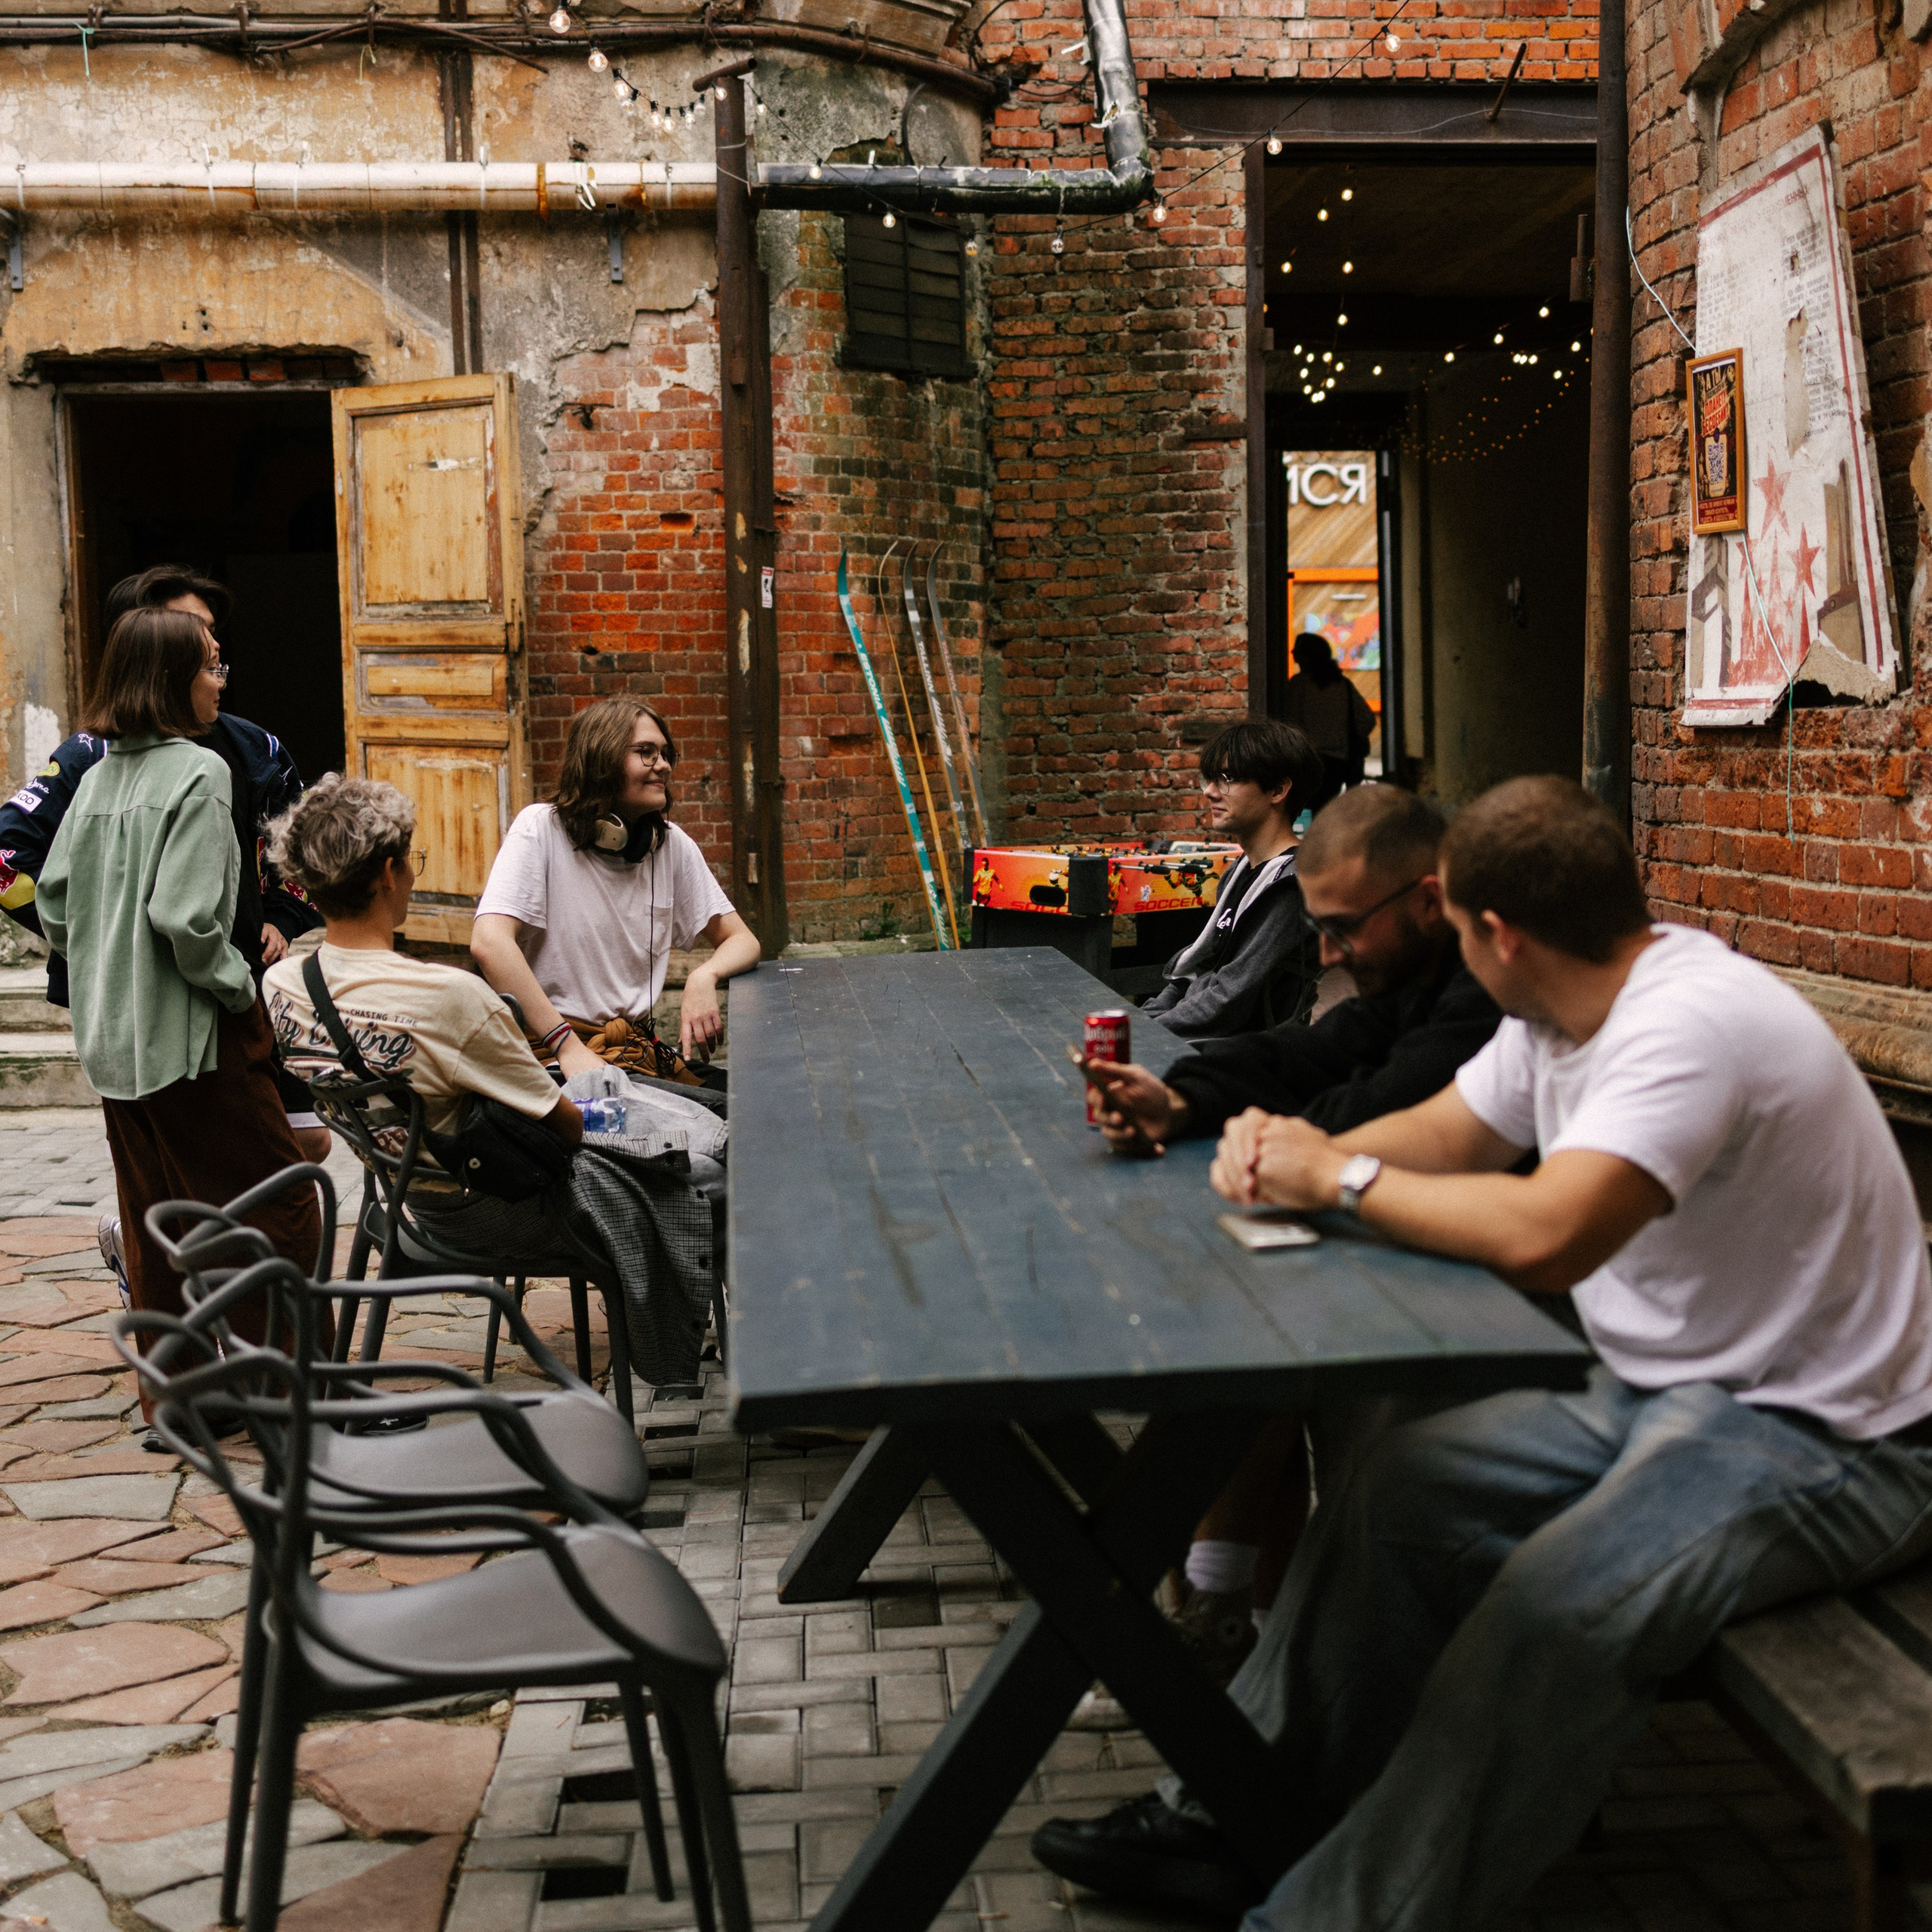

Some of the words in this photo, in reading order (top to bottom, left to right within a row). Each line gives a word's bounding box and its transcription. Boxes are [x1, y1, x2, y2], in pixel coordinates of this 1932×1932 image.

[860, 653, 882, 710] ESTONIA
[918, 641, 935, 693] TALLINN
[1134, 896, 1204, 912] SOCCER
[350, 1009, 388, 1021] CHASING
[394, 1015, 418, 1027] TIME
